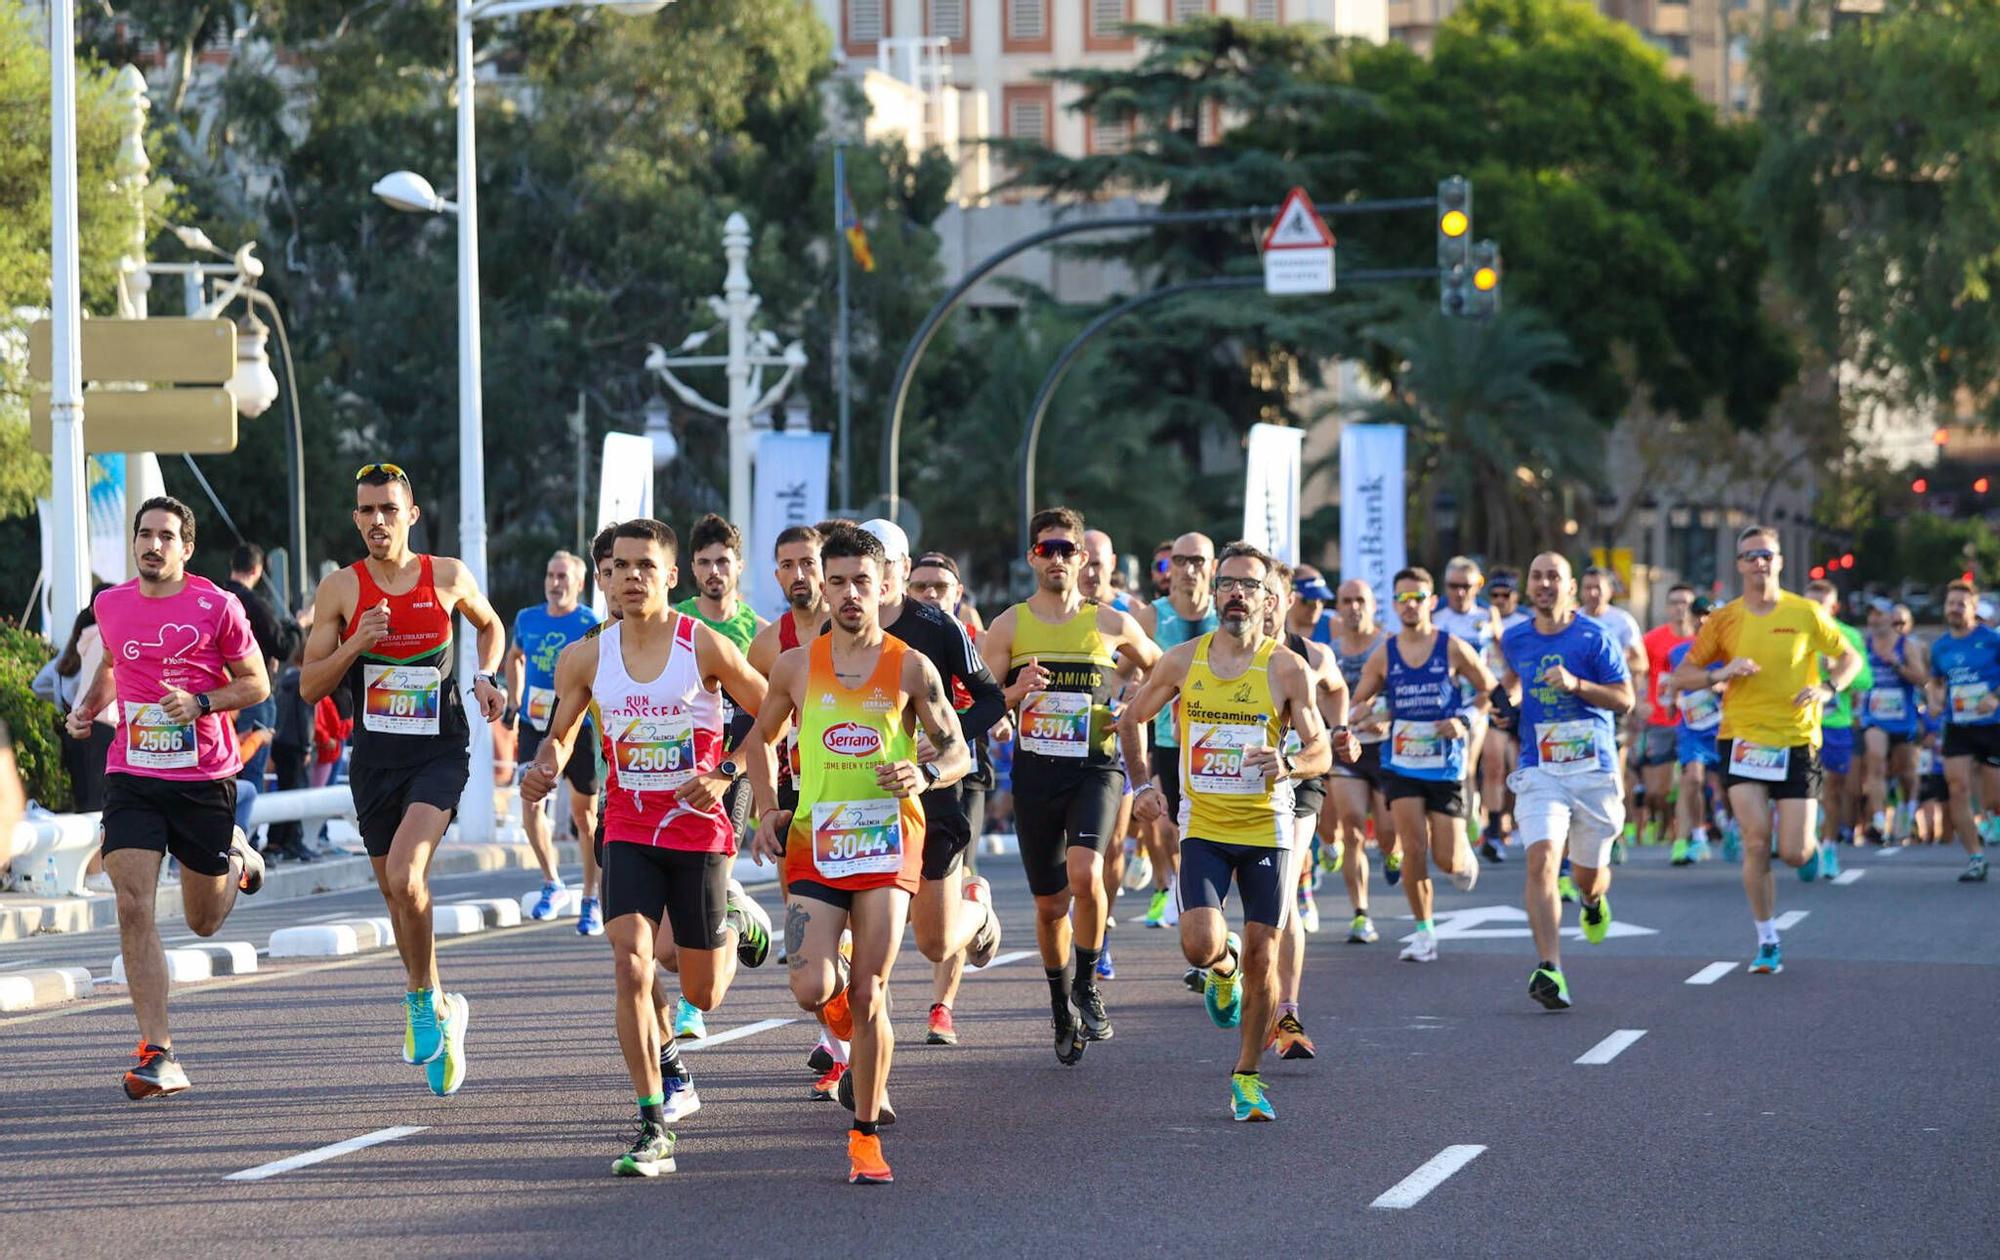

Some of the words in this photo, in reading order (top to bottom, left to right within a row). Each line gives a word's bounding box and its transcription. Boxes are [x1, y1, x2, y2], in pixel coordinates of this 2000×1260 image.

[1356, 474, 1383, 623] xaBank
[1048, 671, 1102, 688] CAMINOS
[388, 694, 417, 716] 181
[626, 695, 650, 707] RUN
[1187, 709, 1259, 722] correcamino
[828, 731, 879, 747] Serrano
[1031, 717, 1075, 740] 3314
[139, 730, 184, 752] 2566
[628, 746, 681, 772] 2509
[1201, 752, 1240, 776] 259
[829, 831, 888, 860] 3044
